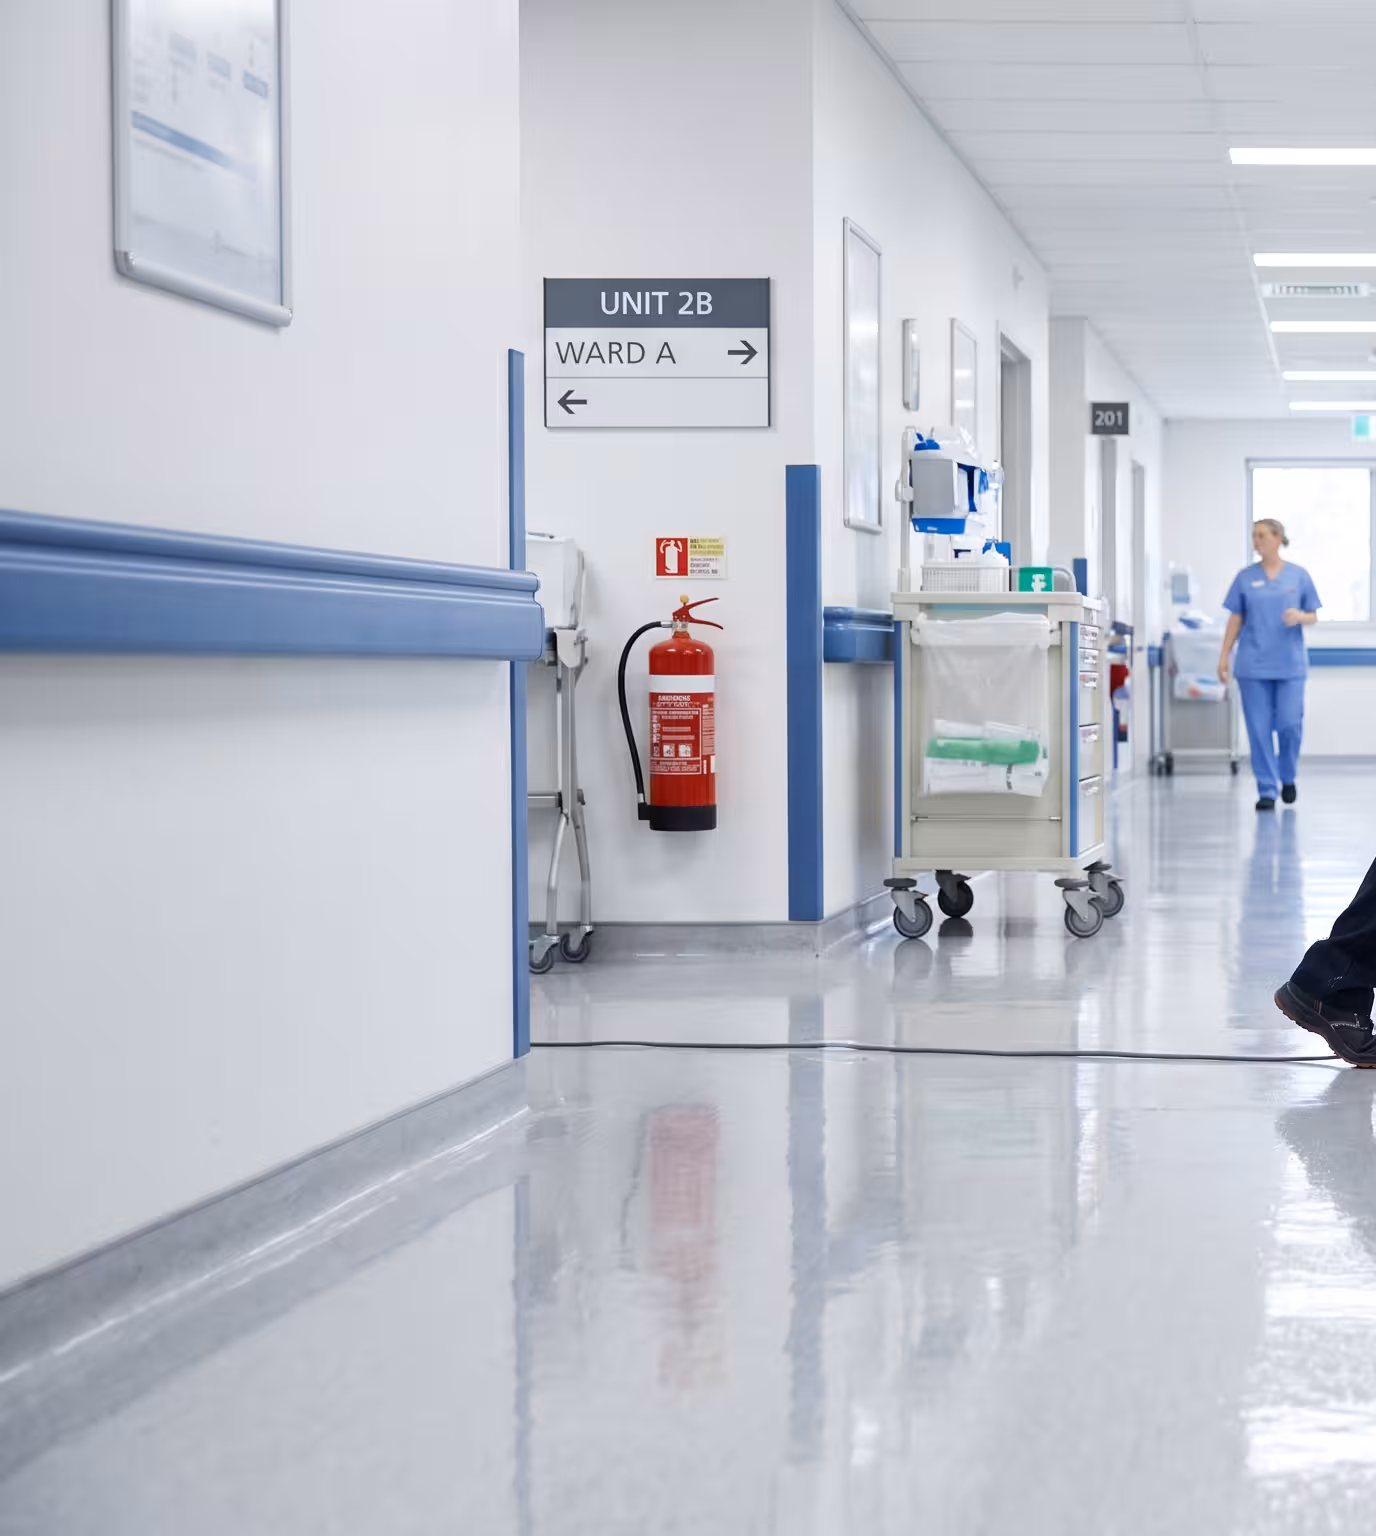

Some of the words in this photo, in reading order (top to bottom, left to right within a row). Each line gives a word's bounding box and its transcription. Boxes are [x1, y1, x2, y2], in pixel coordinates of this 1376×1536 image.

[600, 291, 670, 315] UNIT
[678, 291, 713, 315] 2B
[555, 341, 646, 364] WARD
[655, 341, 677, 364] A
[1095, 410, 1123, 426] 201
